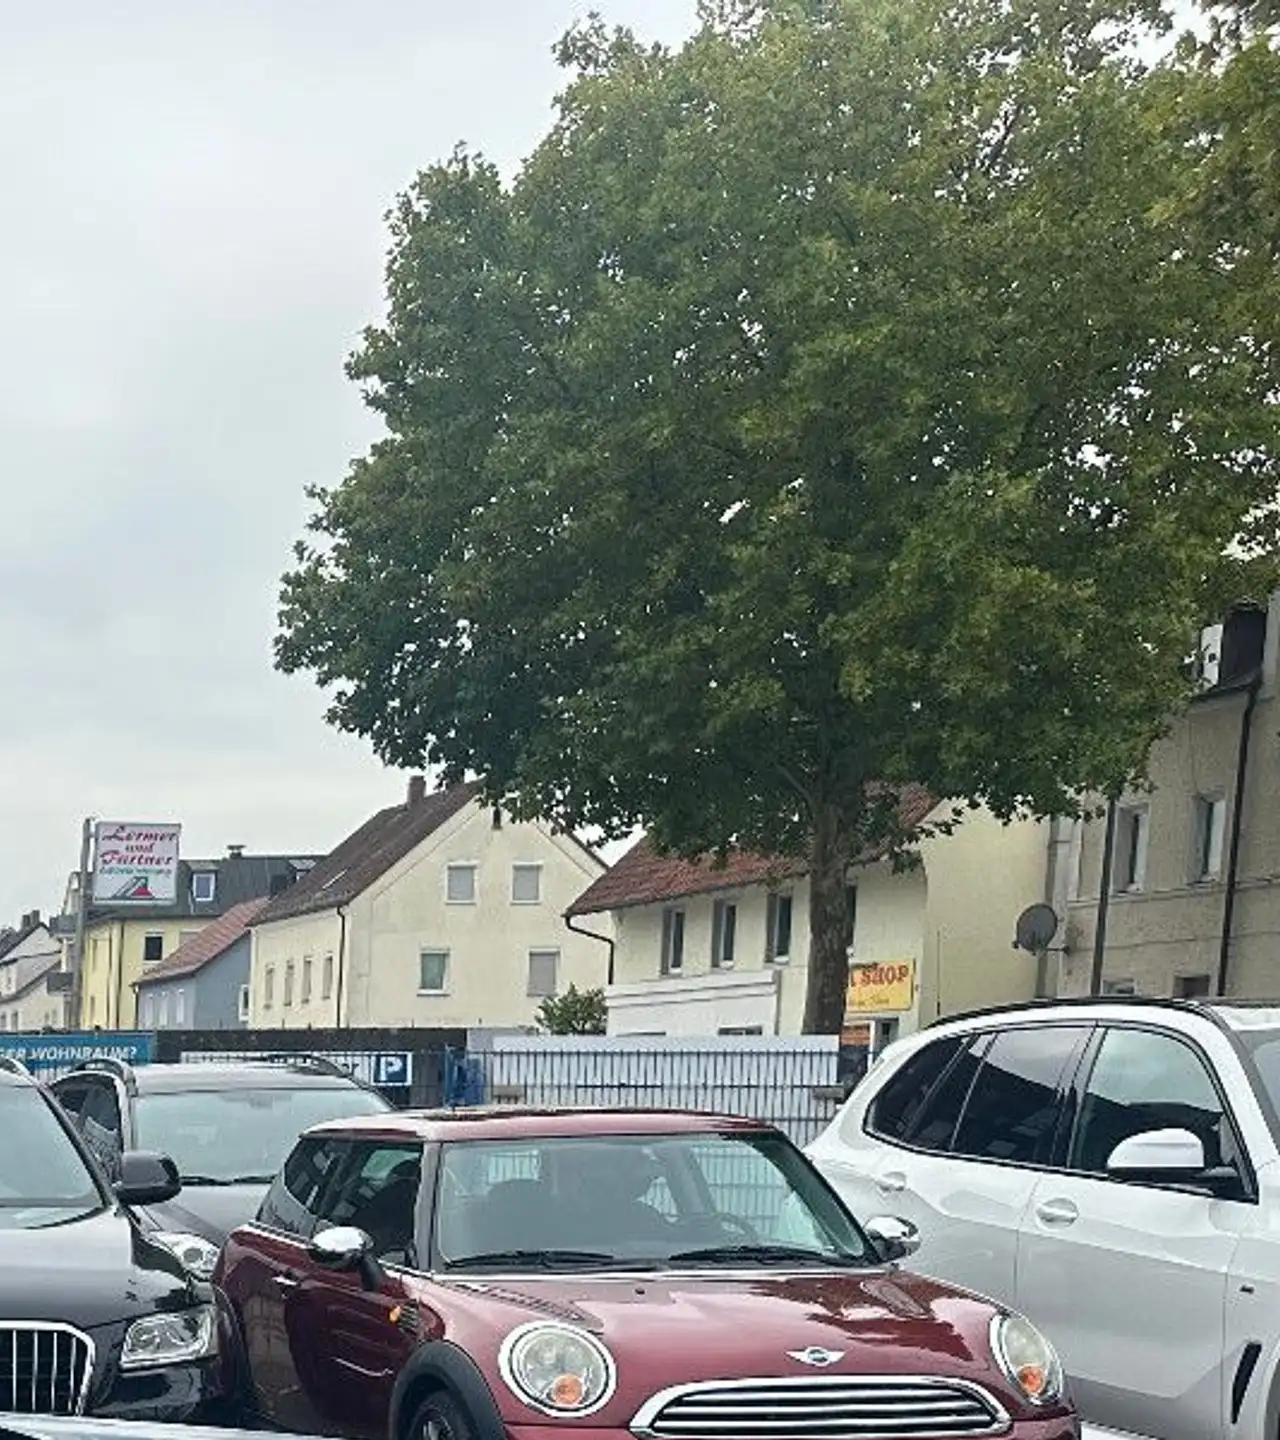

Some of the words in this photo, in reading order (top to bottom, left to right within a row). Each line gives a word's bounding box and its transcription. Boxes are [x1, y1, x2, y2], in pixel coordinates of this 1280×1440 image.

[101, 825, 177, 841] Lermer
[100, 850, 173, 866] Partner
[31, 1046, 137, 1060] WOHNRAUM?
[379, 1055, 403, 1081] P
